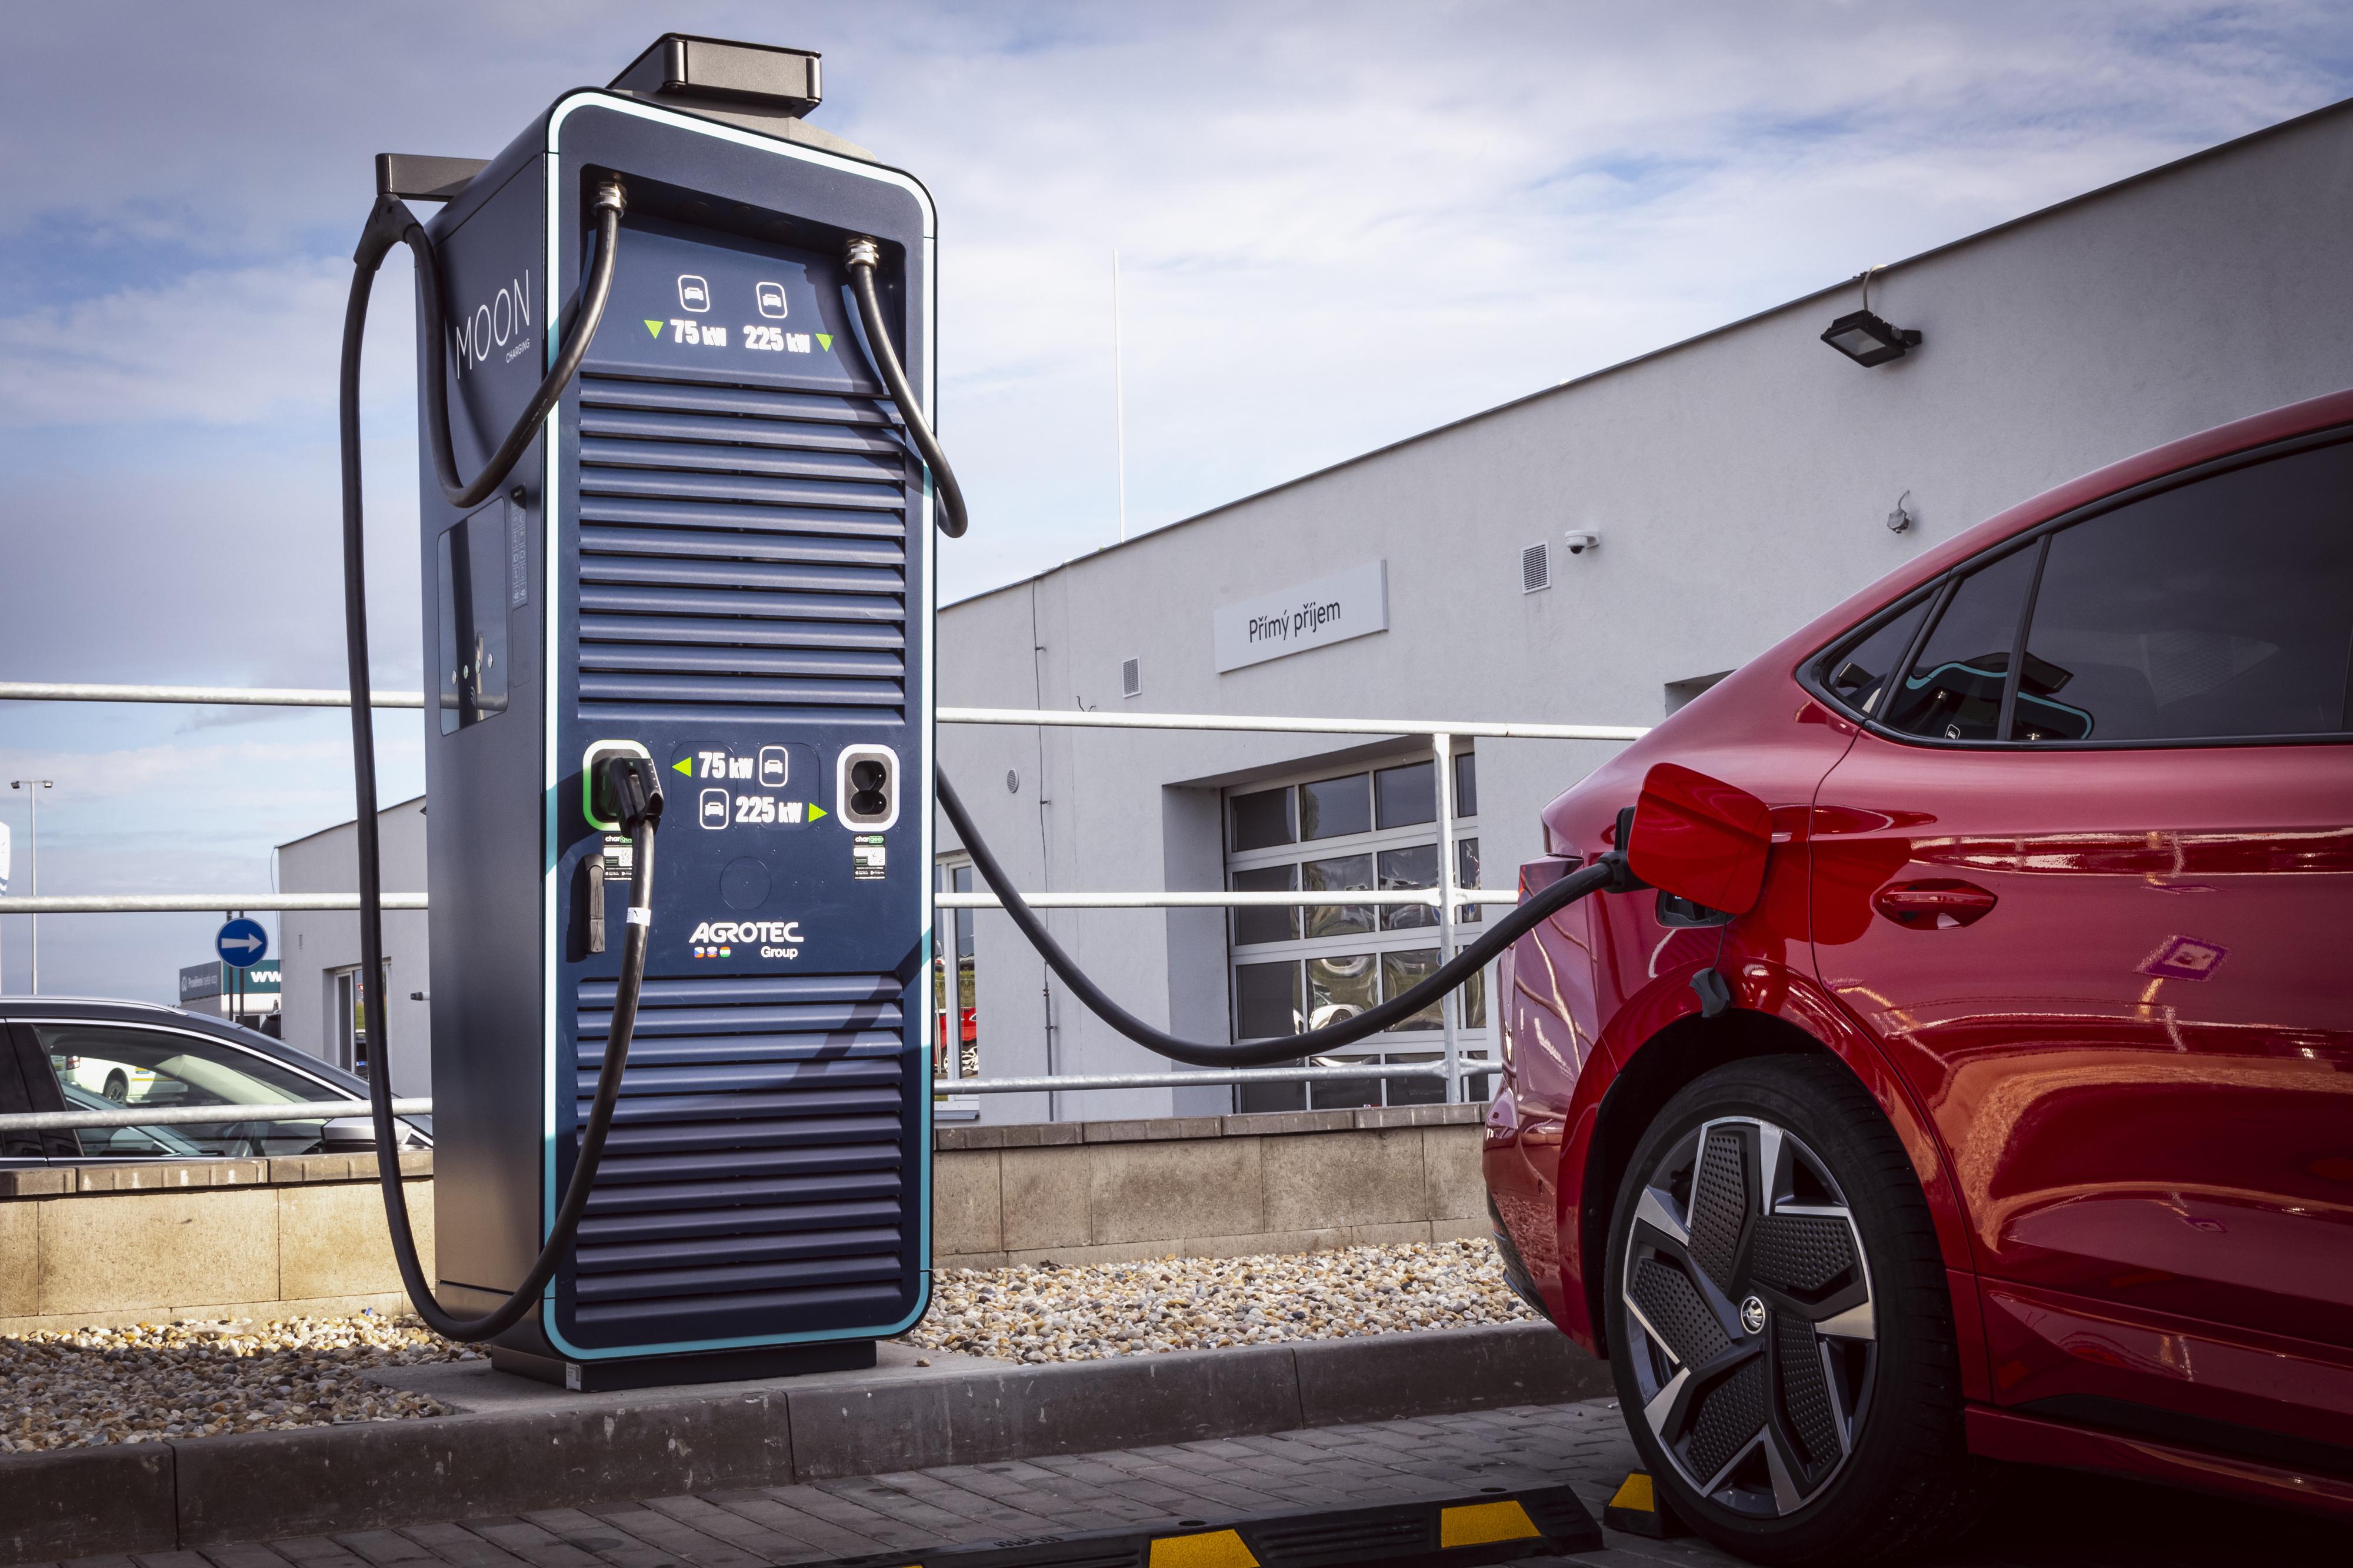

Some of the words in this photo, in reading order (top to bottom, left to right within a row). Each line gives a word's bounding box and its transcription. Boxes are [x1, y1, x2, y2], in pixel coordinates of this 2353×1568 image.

[456, 269, 529, 379] MOON
[670, 319, 699, 345] 75
[702, 326, 726, 347] kW
[506, 338, 530, 363] CHARGING
[743, 325, 784, 351] 225
[786, 333, 810, 353] kW
[1249, 609, 1289, 643] Přímý
[1294, 602, 1341, 638] příjem
[698, 752, 726, 779] 75
[729, 758, 754, 779] kW
[735, 796, 775, 823] 225
[778, 802, 802, 823] kW
[688, 922, 804, 943] AGROTEC
[761, 946, 798, 960] Group
